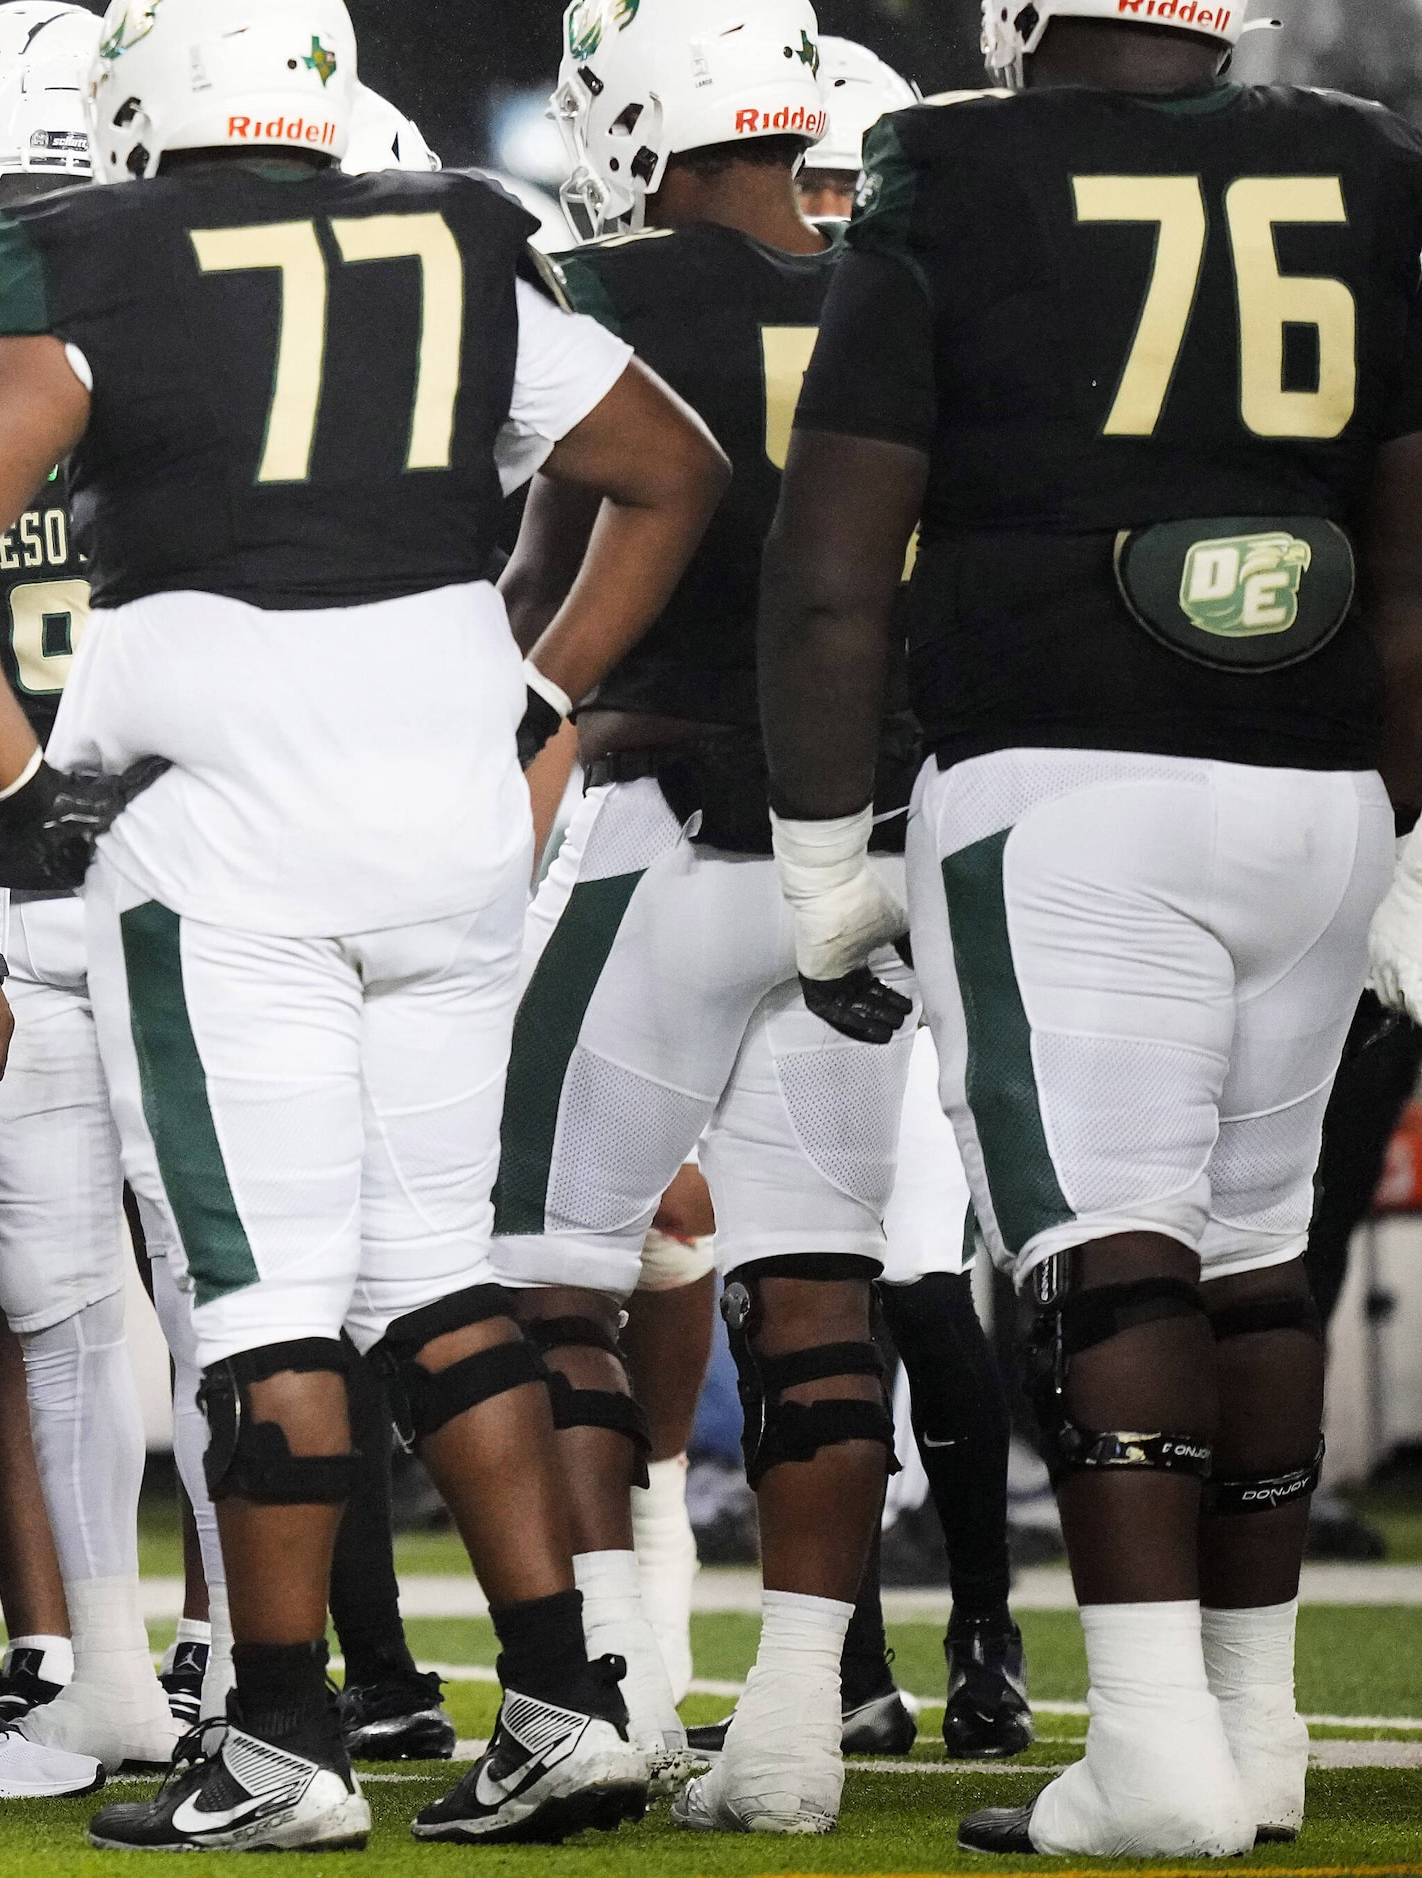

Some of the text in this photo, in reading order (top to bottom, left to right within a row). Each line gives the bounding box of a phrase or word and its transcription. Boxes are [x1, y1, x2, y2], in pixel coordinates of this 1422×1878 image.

[228, 115, 335, 145] Riddell
[735, 105, 827, 136] Riddell
[1070, 175, 1357, 439] 76
[185, 212, 463, 483] 77
[1242, 1476, 1311, 1501] DONJOY
